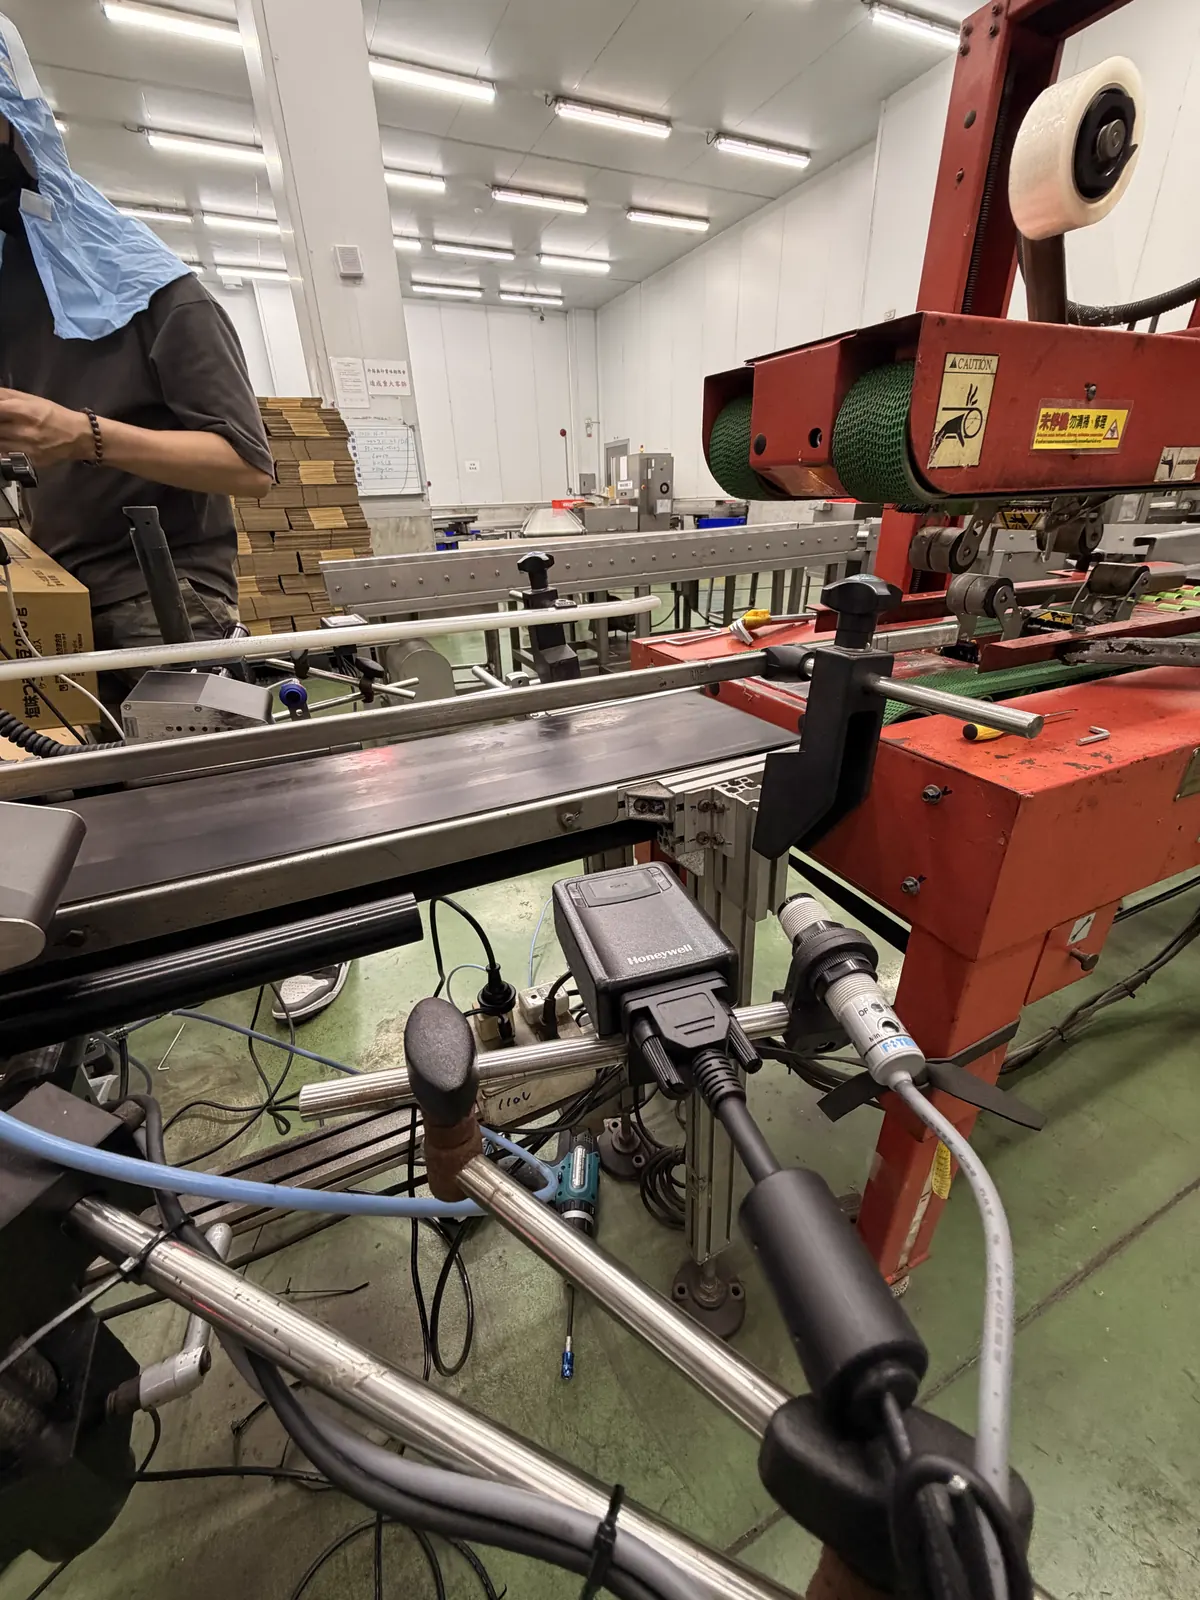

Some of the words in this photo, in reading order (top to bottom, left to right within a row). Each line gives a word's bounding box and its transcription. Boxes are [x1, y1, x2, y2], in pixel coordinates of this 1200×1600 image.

[957, 357, 993, 371] CAUTION
[626, 943, 694, 966] Honeywell
[858, 1007, 869, 1017] OP
